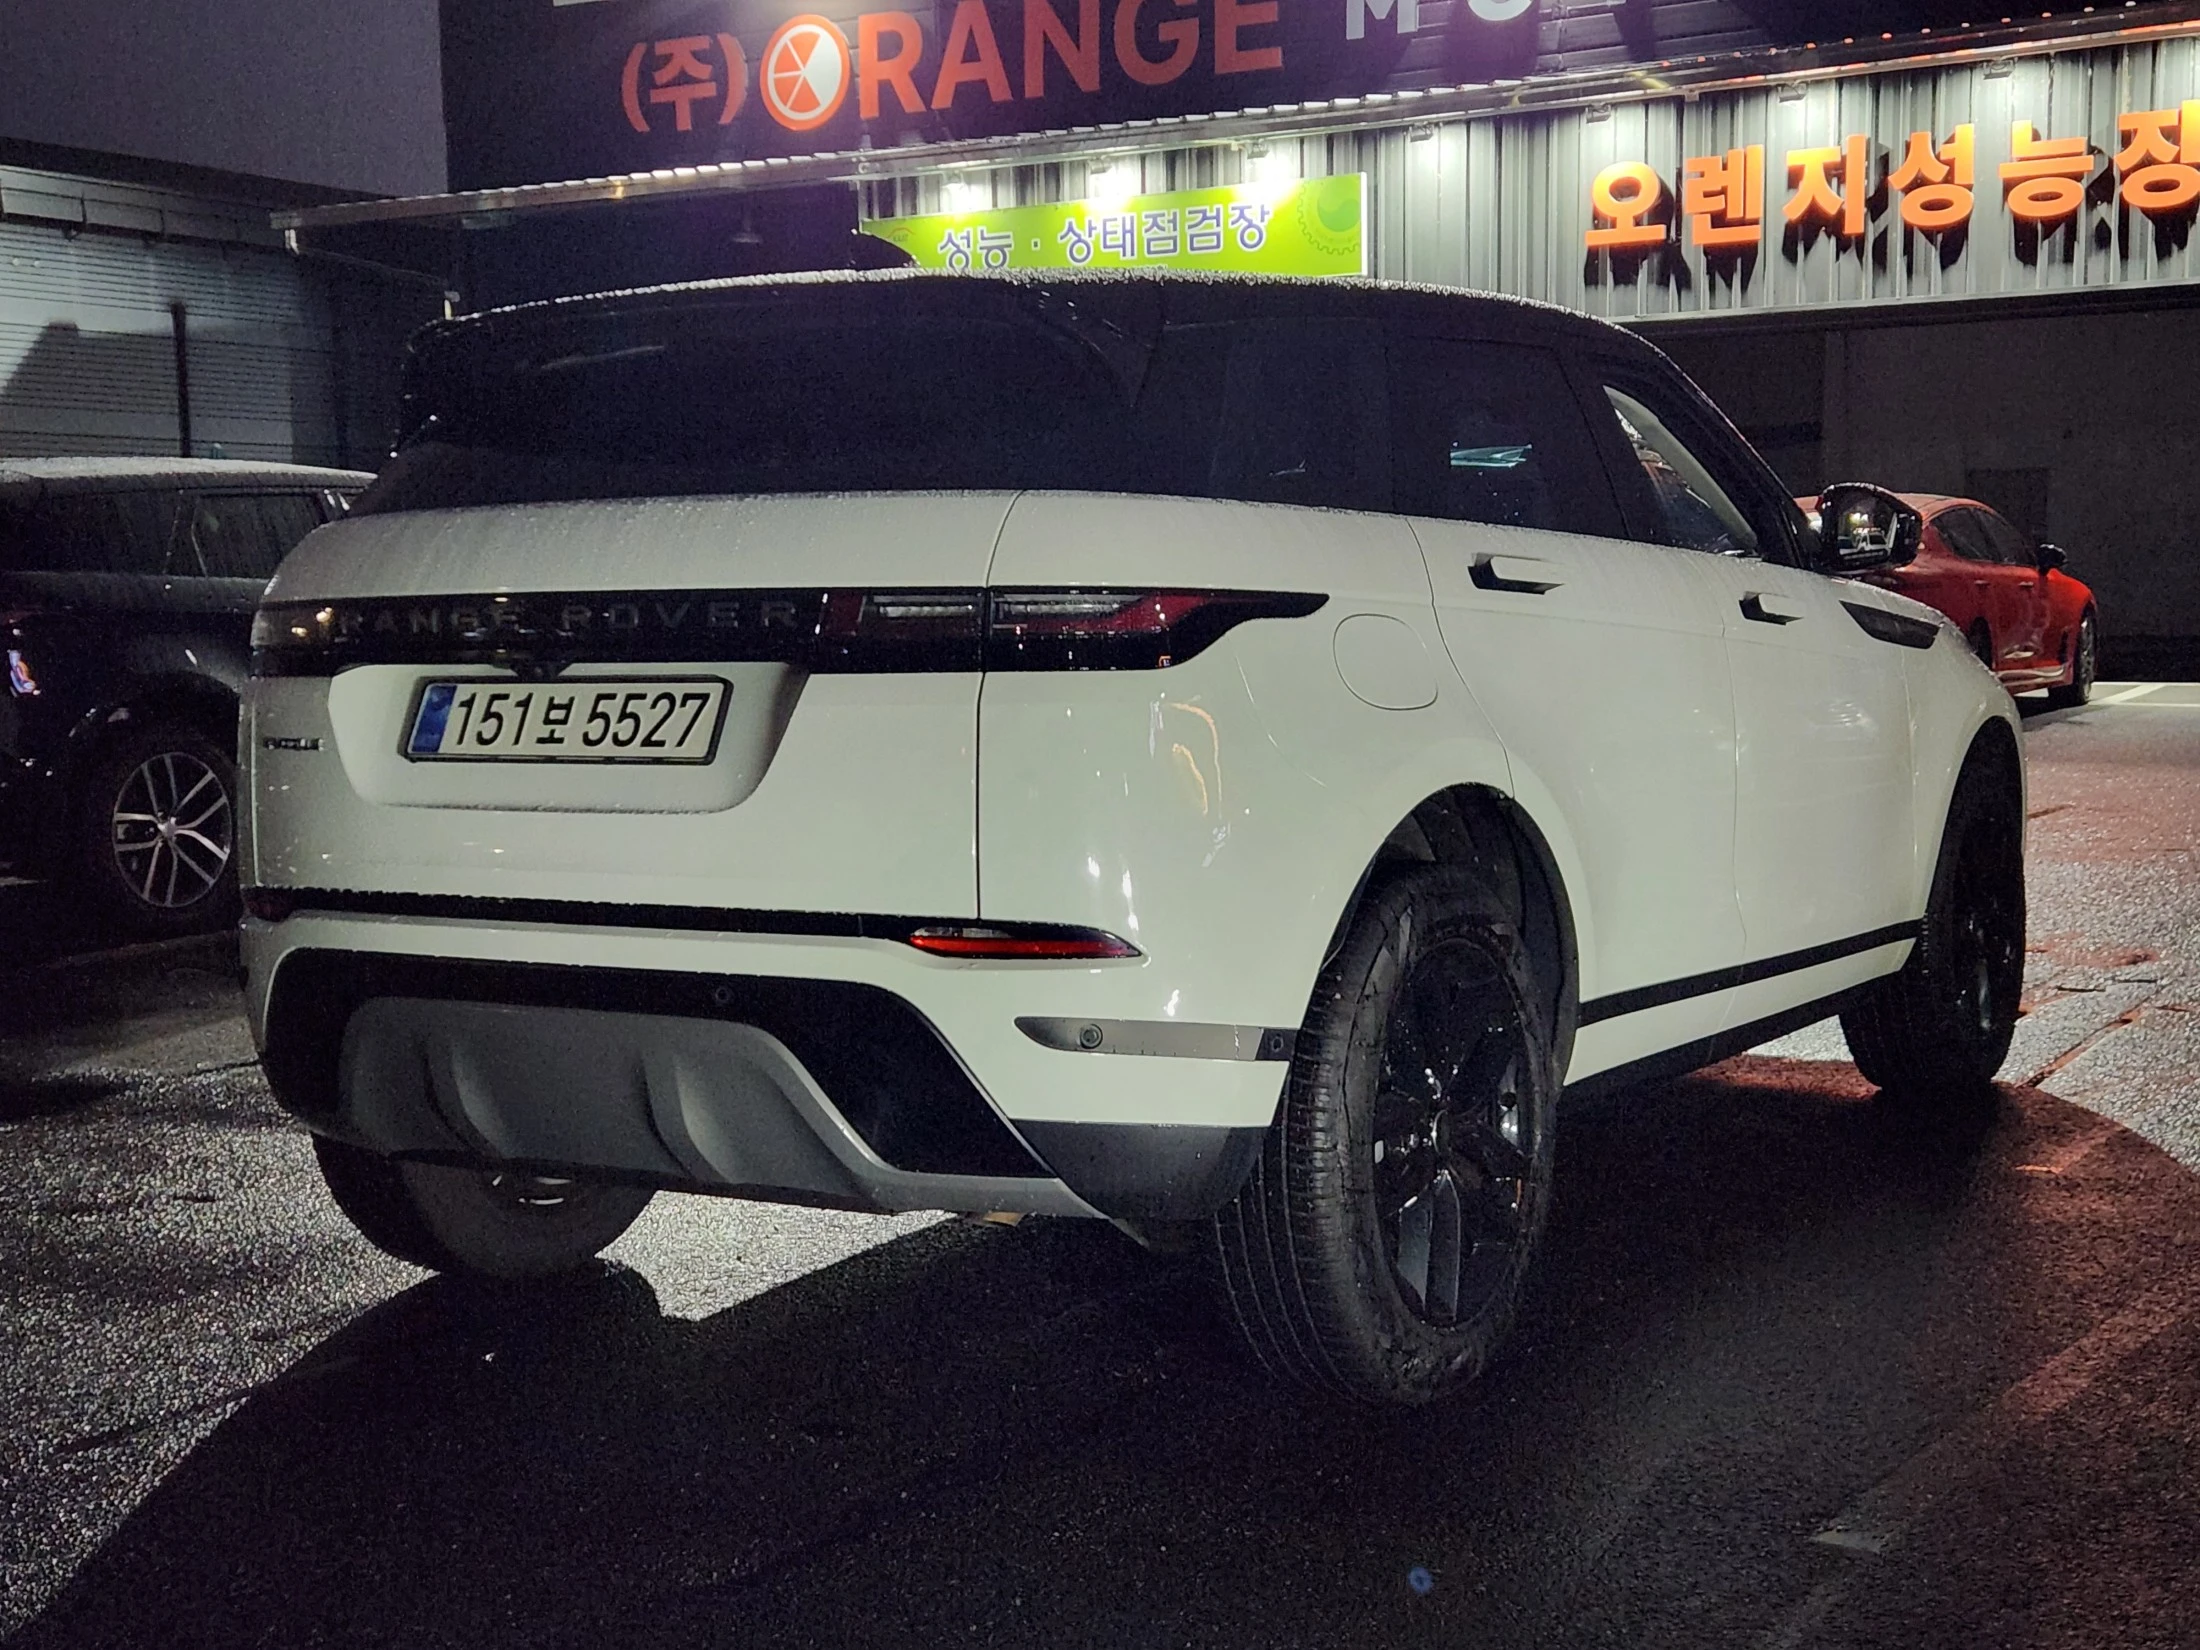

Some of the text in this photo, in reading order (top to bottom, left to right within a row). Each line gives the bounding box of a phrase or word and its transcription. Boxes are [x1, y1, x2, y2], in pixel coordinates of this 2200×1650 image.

[937, 225, 1013, 270] 성능
[1058, 203, 1273, 265] 상태점검장
[562, 600, 797, 631] ROVER
